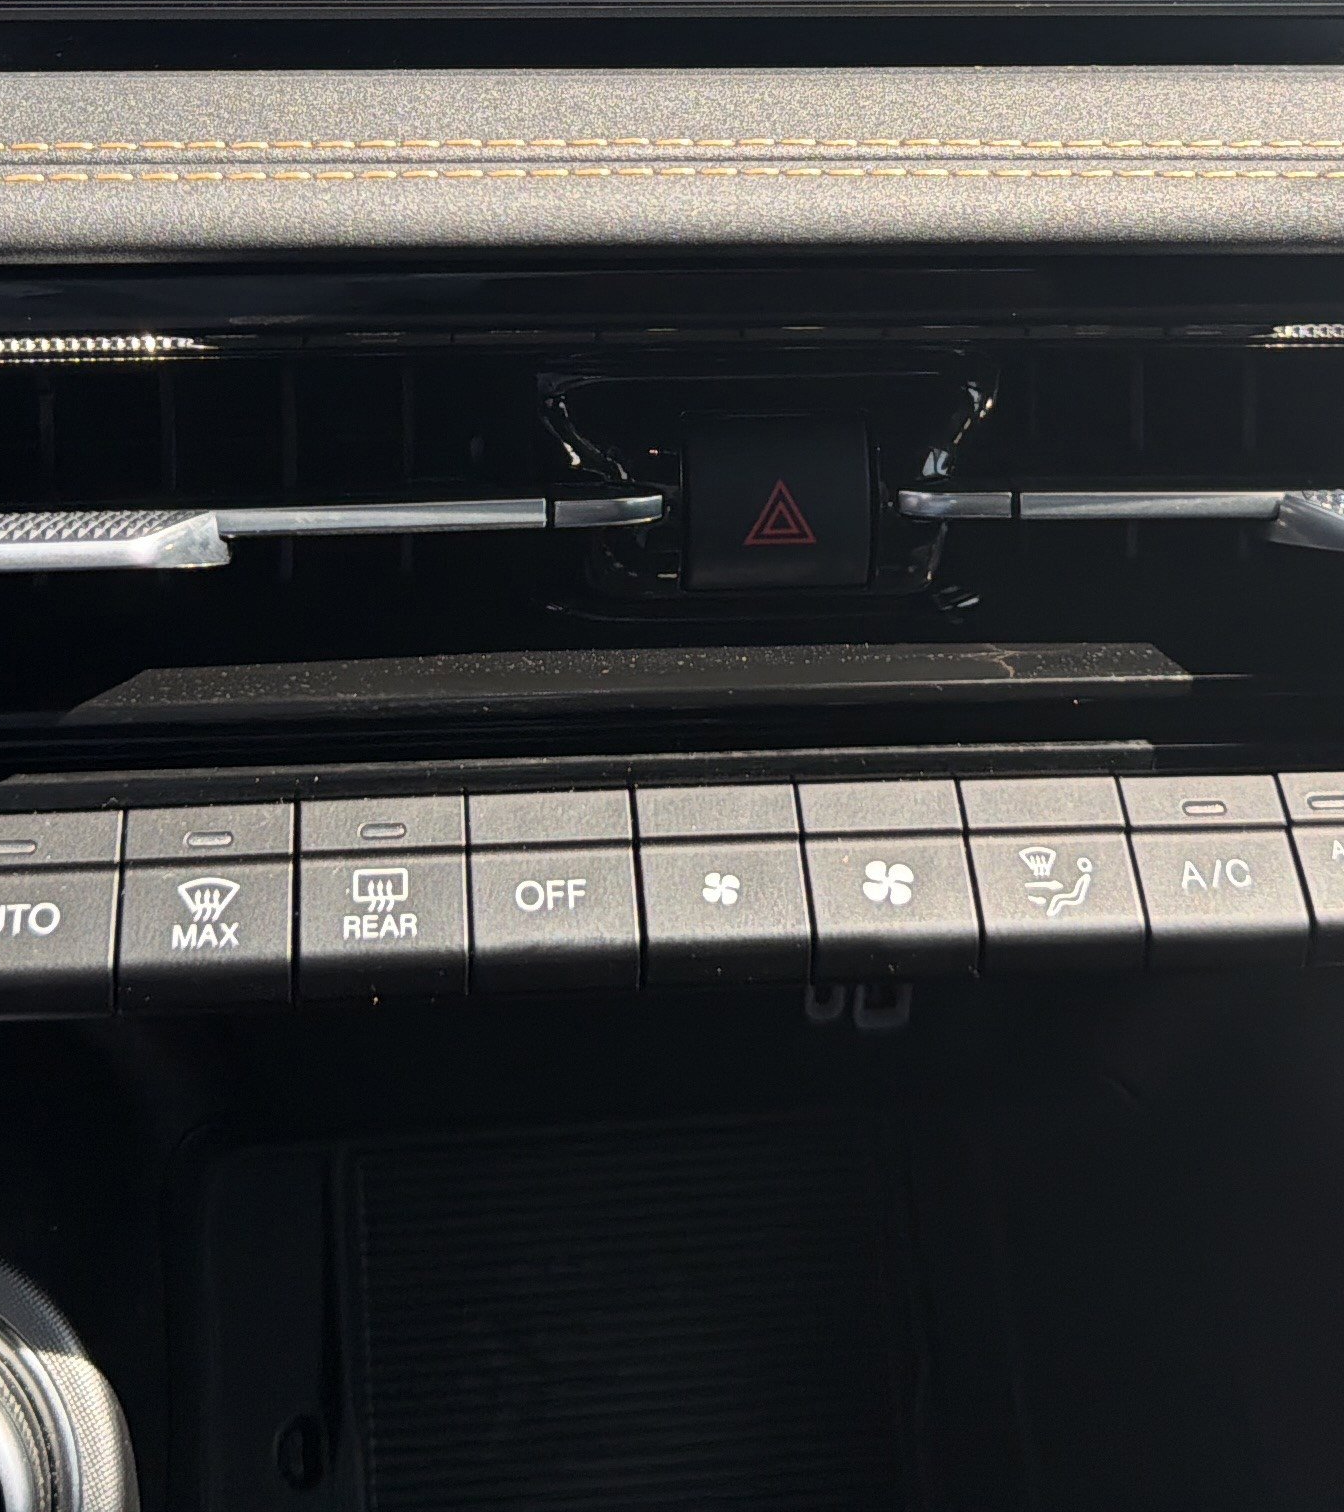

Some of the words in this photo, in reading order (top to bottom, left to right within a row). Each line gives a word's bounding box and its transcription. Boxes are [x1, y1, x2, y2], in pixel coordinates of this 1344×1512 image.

[1181, 857, 1252, 889] A/C
[515, 878, 587, 912] OFF
[171, 922, 241, 950] MAX
[342, 911, 418, 941] REAR
